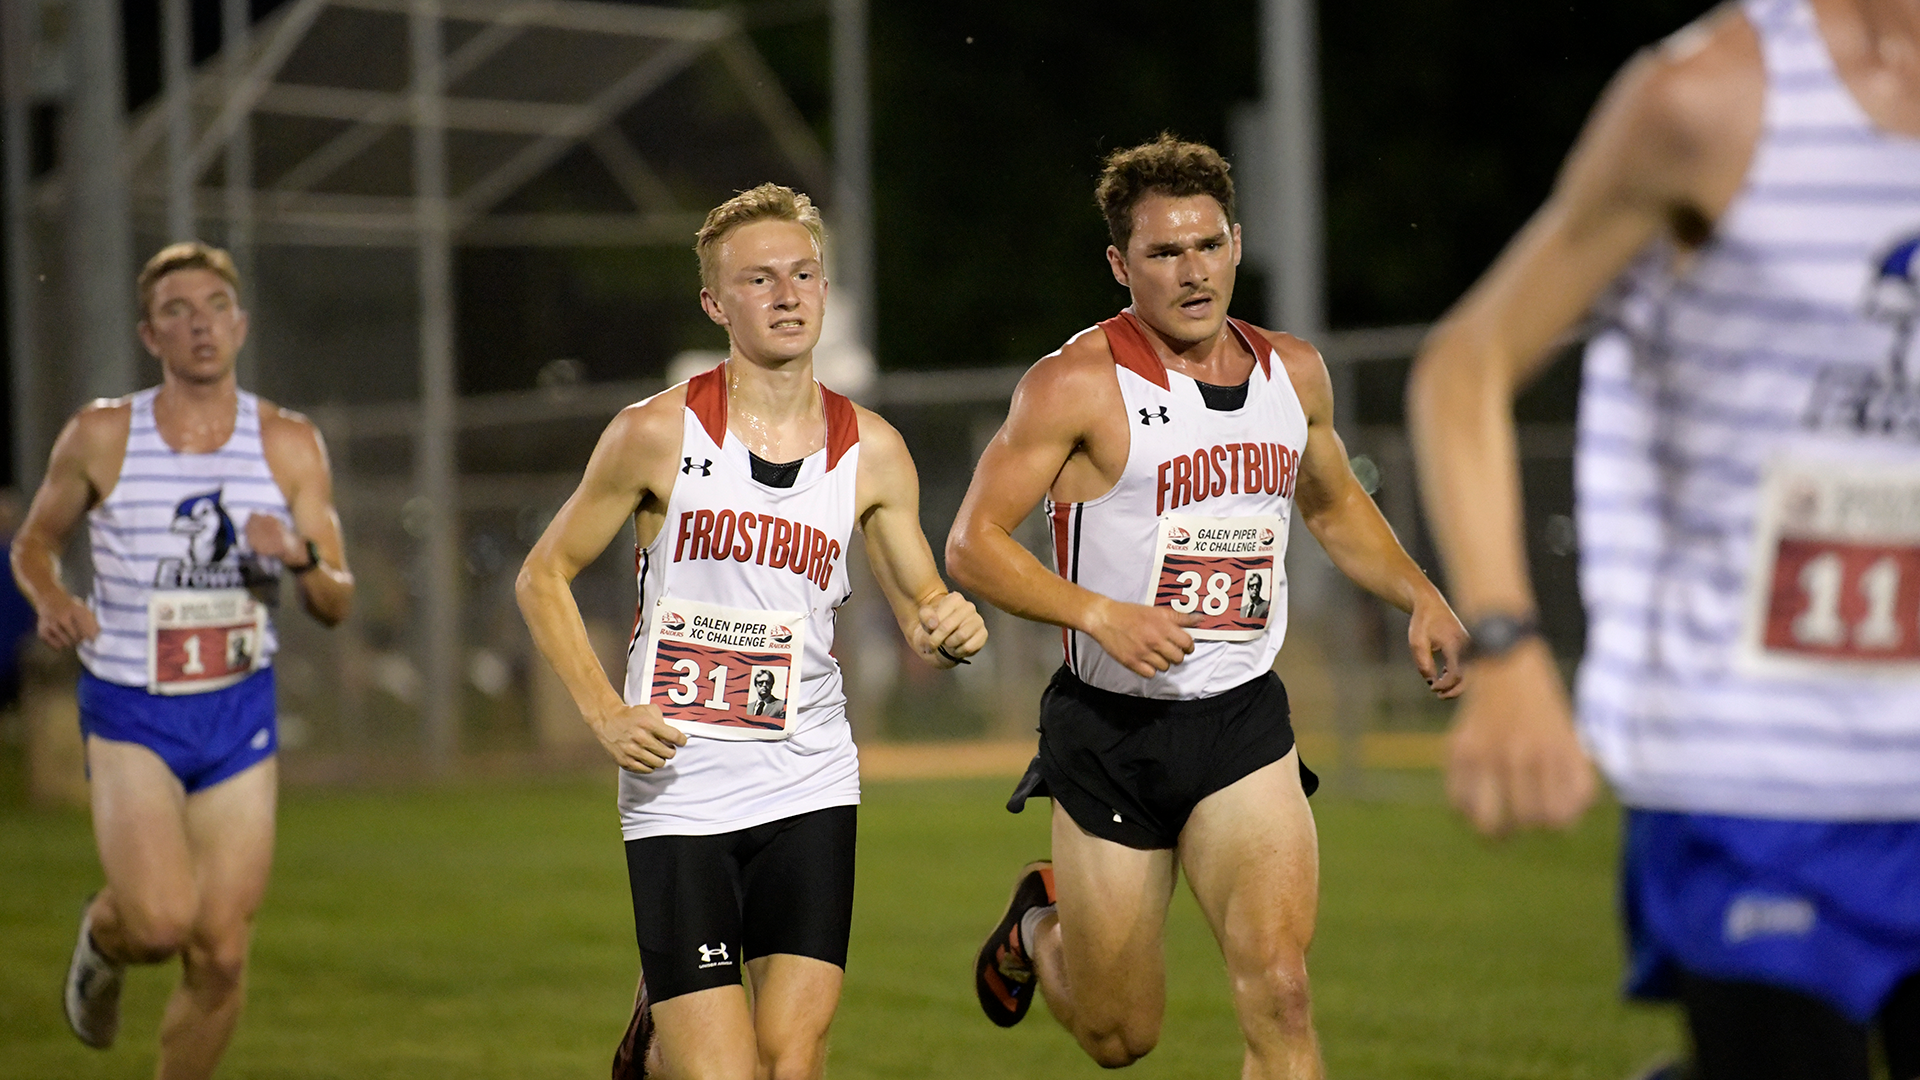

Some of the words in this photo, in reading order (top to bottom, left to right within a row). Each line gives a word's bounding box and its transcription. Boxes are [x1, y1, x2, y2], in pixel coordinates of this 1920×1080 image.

[673, 509, 841, 591] FROSTBURG
[1193, 541, 1207, 552] XC
[1209, 541, 1257, 552] CHALLENGE
[1197, 529, 1231, 540] GALEN
[1232, 529, 1257, 540] PIPER
[1170, 570, 1232, 616] 38
[1791, 551, 1903, 648] 11
[689, 628, 705, 640] XC
[706, 630, 767, 648] CHALLENGE
[693, 615, 730, 632] GALEN
[733, 622, 767, 635] PIPER
[181, 634, 205, 676] 1
[667, 658, 731, 711] 31
